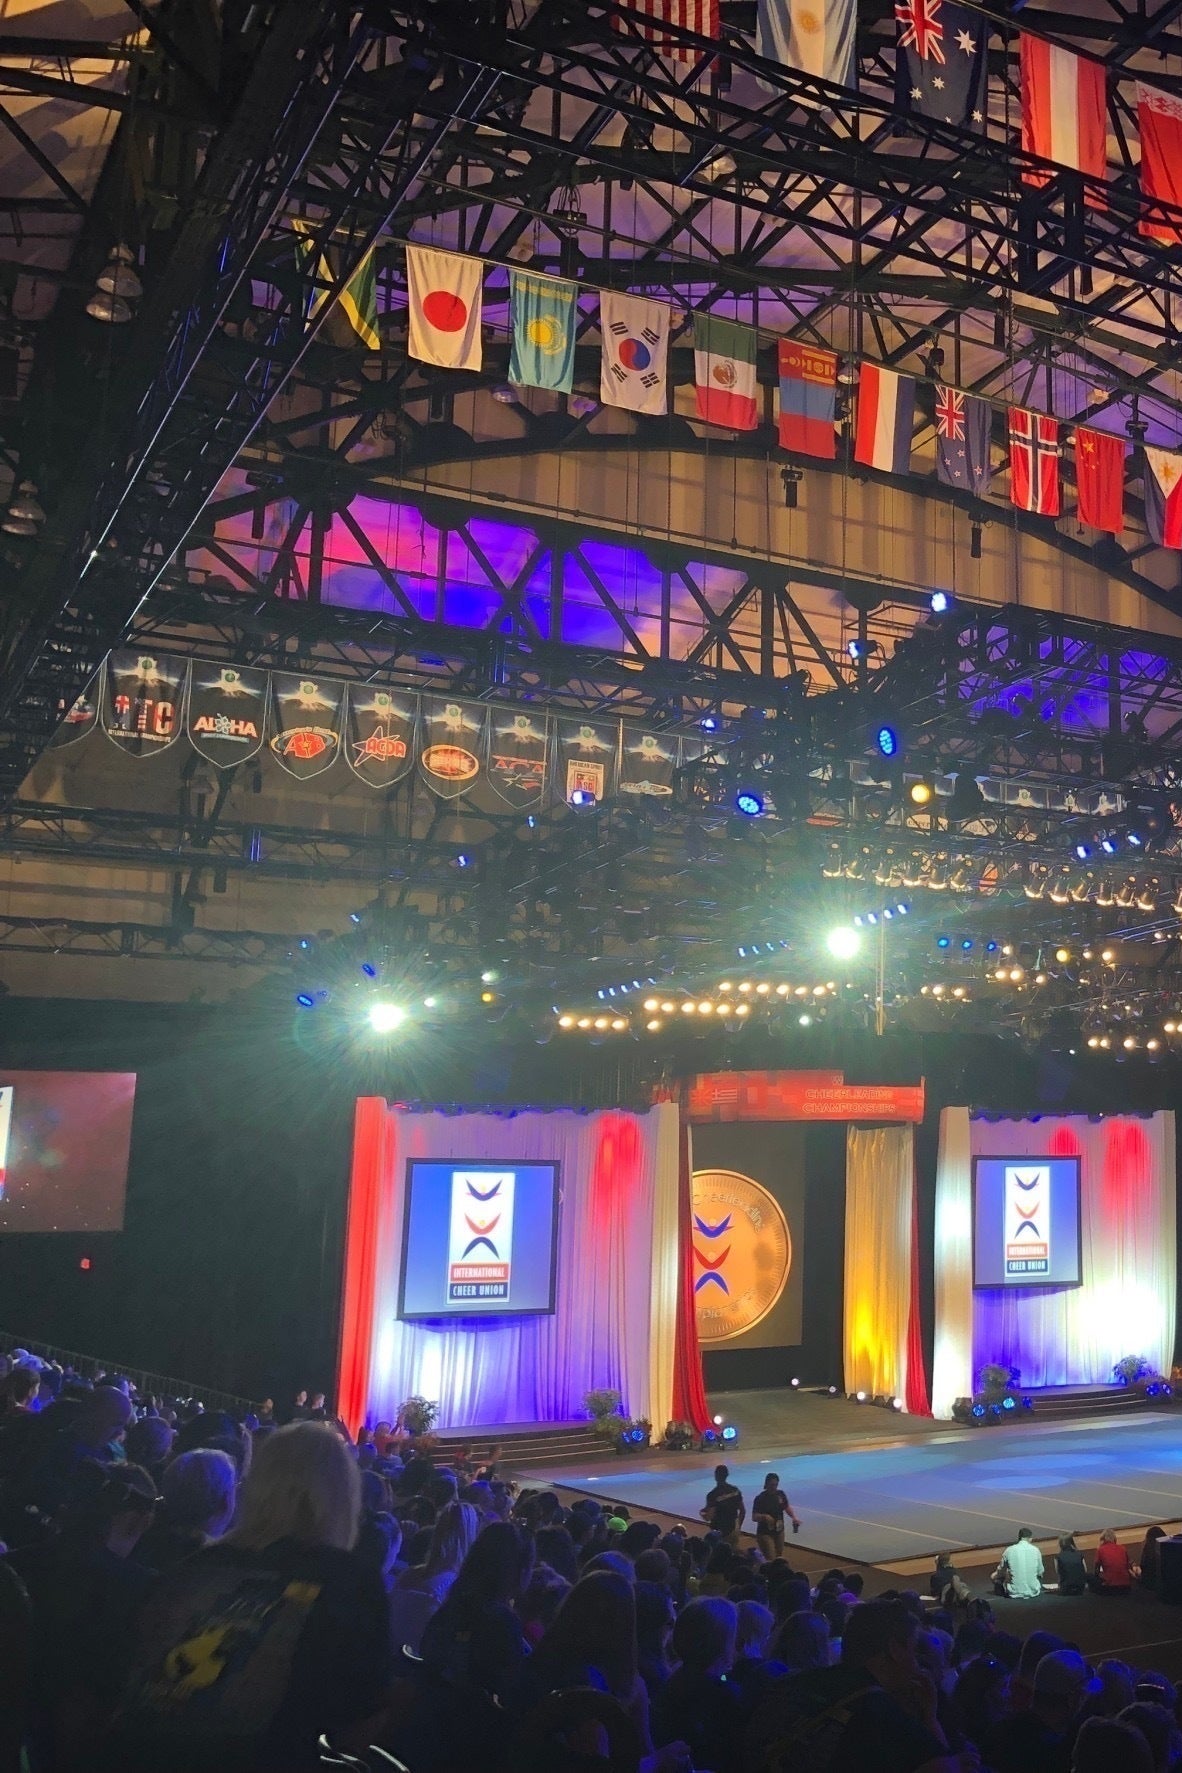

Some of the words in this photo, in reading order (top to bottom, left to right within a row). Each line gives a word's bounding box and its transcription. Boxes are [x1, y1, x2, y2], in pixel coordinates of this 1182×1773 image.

[194, 713, 258, 738] ALOHA
[802, 1102, 896, 1114] CHAMPIONSHIPS
[1008, 1261, 1026, 1271] CHEER
[1027, 1260, 1046, 1270] UNION
[453, 1267, 505, 1278] INTERNATIONAL
[453, 1285, 477, 1296] CHEER
[479, 1284, 504, 1295] UNION
